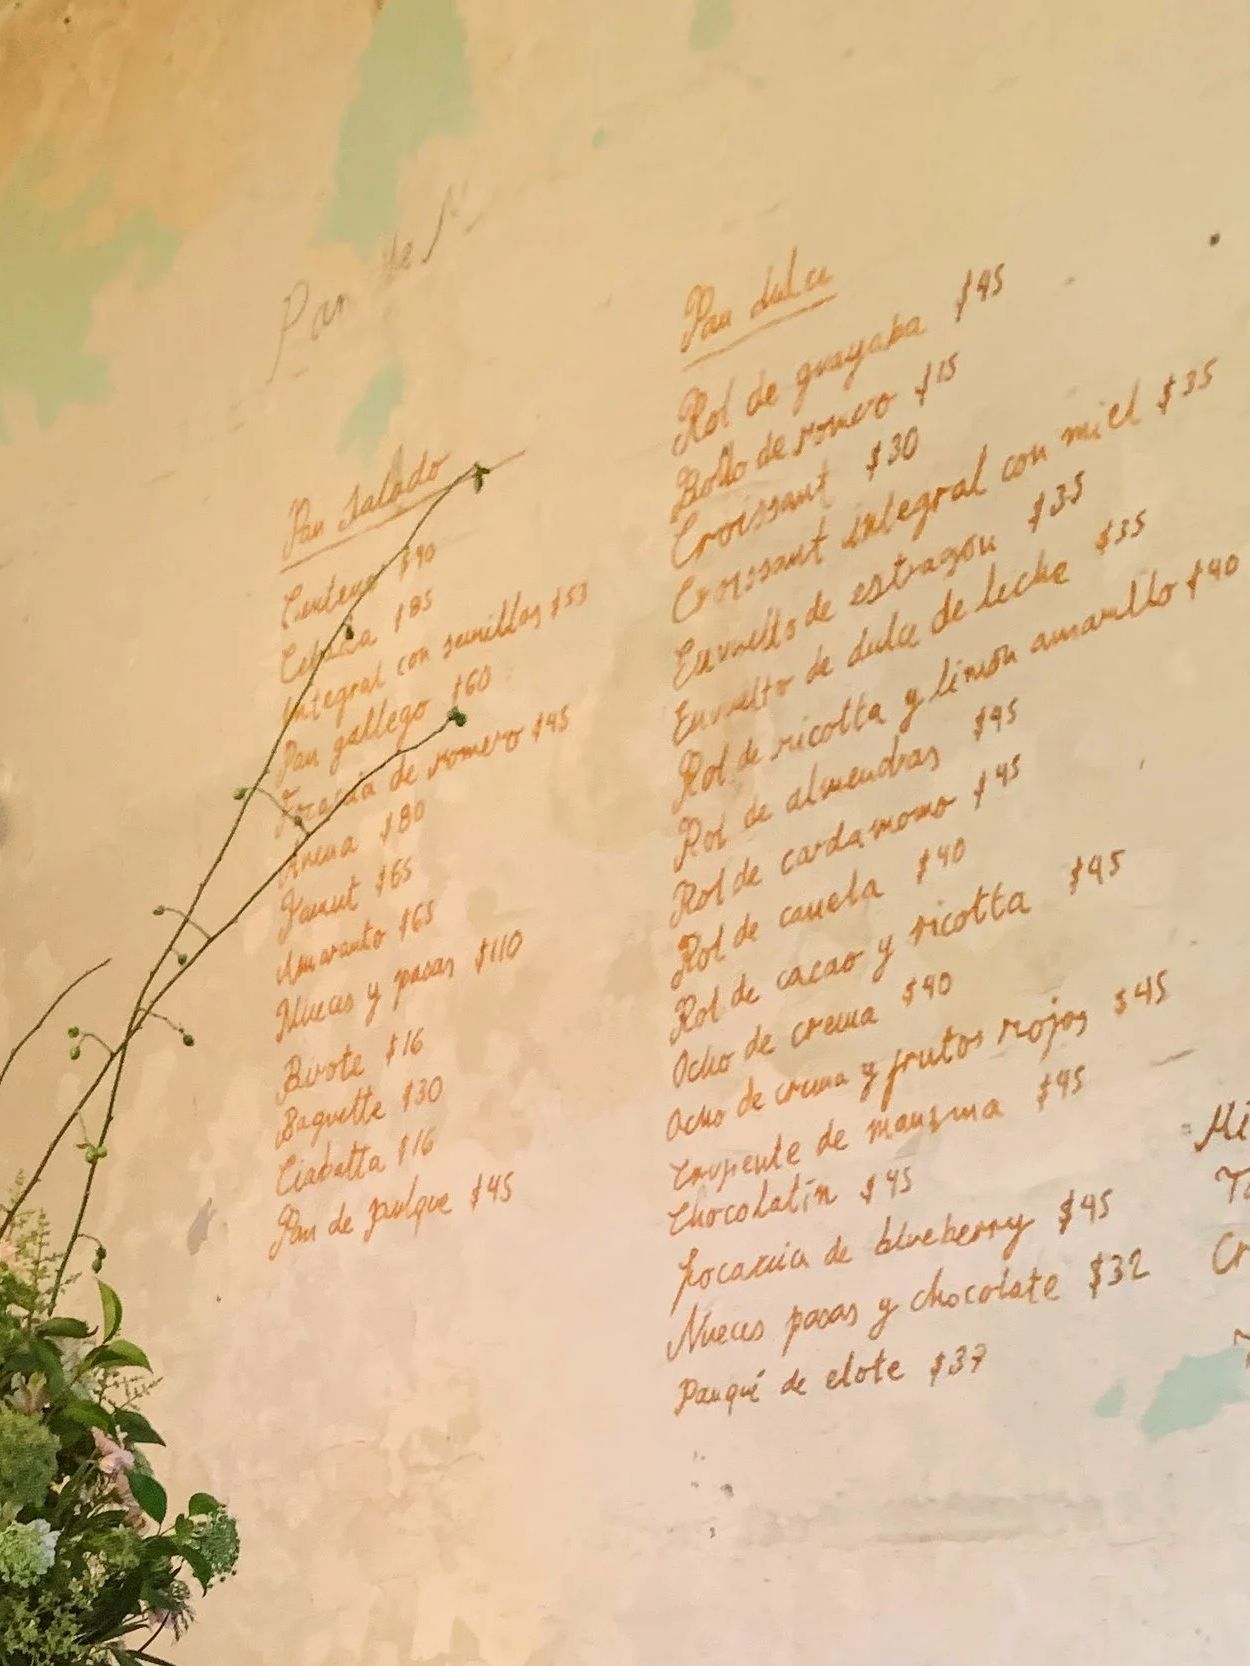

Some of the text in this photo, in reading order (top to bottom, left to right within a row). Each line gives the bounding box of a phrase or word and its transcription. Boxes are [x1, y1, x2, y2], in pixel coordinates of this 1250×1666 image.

[681, 245, 835, 352] Pan dulce
[747, 369, 778, 416] de
[793, 312, 926, 416] guayaba
[755, 430, 786, 468] de
[792, 392, 898, 456] romero
[914, 351, 959, 407] $15
[672, 426, 918, 568] Croissant $30
[842, 442, 987, 550] integral
[1001, 442, 1048, 482] con
[1060, 378, 1141, 448] miel
[1156, 356, 1218, 415] $35
[283, 497, 325, 562] Pan
[805, 590, 836, 626] de
[1028, 470, 1085, 533] $35
[396, 645, 430, 676] con
[444, 590, 541, 660] semillas
[806, 644, 834, 684] de
[848, 610, 920, 667] dulce
[930, 588, 967, 635] de
[974, 549, 1070, 613] leche
[1094, 509, 1147, 556] $35
[736, 737, 763, 773] de
[770, 690, 887, 761] ricotta
[1031, 569, 1178, 653] amarillo
[1187, 553, 1240, 601] $40
[276, 663, 492, 788] Pan gallego $60
[389, 752, 418, 792] de
[428, 724, 525, 781] romero
[531, 703, 571, 743] $45
[743, 797, 774, 830] de
[786, 735, 941, 814] almendras
[973, 697, 1019, 741] $45
[380, 799, 426, 843] $80
[733, 857, 763, 897] de
[781, 796, 958, 876] cardamomo
[974, 753, 1022, 811] $45
[374, 857, 412, 898] $65
[731, 973, 761, 1008] de
[777, 950, 865, 991] cacao
[872, 935, 895, 984] y
[909, 882, 1032, 947] ricotta
[1069, 848, 1127, 896] $45
[733, 913, 759, 949] de
[778, 868, 886, 929] canela
[915, 837, 967, 885] $40
[276, 899, 435, 986] Amaranto $65
[365, 982, 382, 1027] y
[393, 957, 455, 1012] pasas
[474, 928, 524, 975] $110
[385, 1026, 425, 1067] $16
[667, 969, 1168, 1141] Ocho de crema y frutos rojos $45
[673, 971, 953, 1089] Ocho de crema $40
[275, 1075, 443, 1150] Baguette $30
[275, 1125, 437, 1196] Ciabatta $16
[815, 1118, 849, 1157] de
[865, 1098, 1004, 1144] manzana
[1037, 1065, 1086, 1112] $45
[269, 1170, 515, 1261] Pan de pulque $45
[824, 1235, 853, 1265] de
[874, 1212, 1036, 1261] blueberry
[1058, 1188, 1113, 1235] $45
[860, 1165, 912, 1205] $45
[667, 1247, 1151, 1363] Nueces pasas y chocolate $32
[673, 1342, 988, 1417] Panqué de elote $37
